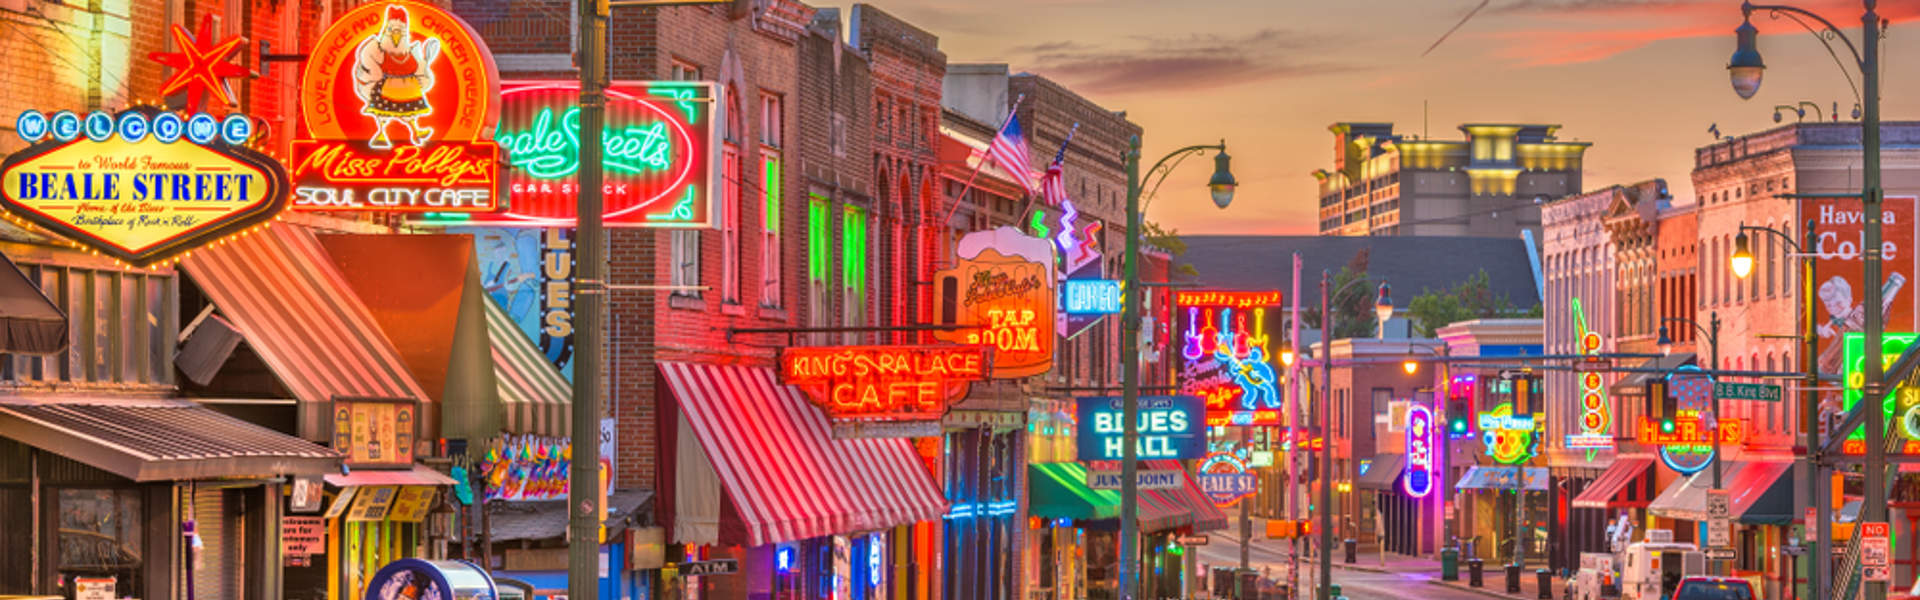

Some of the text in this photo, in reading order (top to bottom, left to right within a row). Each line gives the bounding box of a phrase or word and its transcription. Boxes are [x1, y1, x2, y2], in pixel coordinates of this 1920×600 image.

[352, 12, 380, 34] AND
[422, 15, 468, 66] CHICKEN
[20, 113, 249, 141] WELCOME
[499, 107, 670, 178] eale Seets
[78, 155, 191, 170] to World Famous
[296, 145, 382, 176] Miss
[19, 172, 253, 201] BEALE STREET
[295, 186, 490, 207] SOUL CITY CAFE
[512, 183, 627, 194] GAR SCK
[1883, 210, 1896, 224] a
[1816, 230, 1897, 261] Coe
[545, 228, 572, 338] LUES
[988, 310, 1035, 329] TAP
[1585, 333, 1600, 429] DERS
[834, 382, 938, 408] CAFE
[1094, 474, 1122, 486] JUK
[1199, 476, 1233, 491] EALE
[1709, 503, 1727, 514] 25
[1866, 526, 1884, 535] NO
[690, 562, 728, 573] ATM
